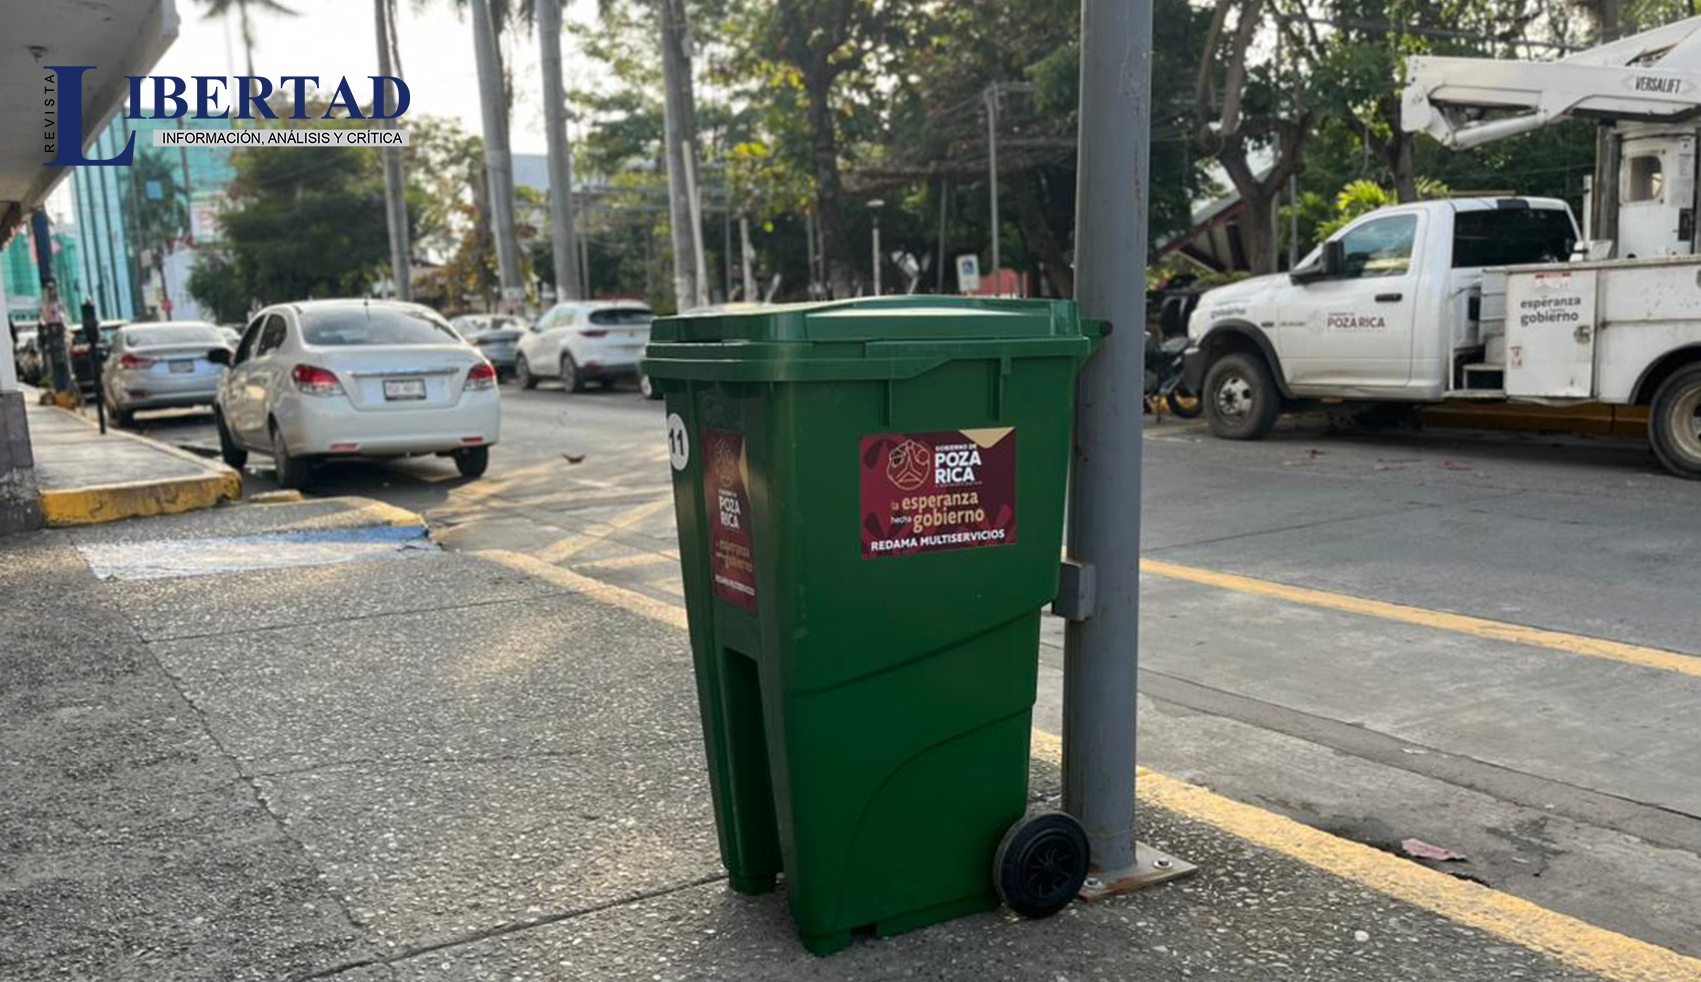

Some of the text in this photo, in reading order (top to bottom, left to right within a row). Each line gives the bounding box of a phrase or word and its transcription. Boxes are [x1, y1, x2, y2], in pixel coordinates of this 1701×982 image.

[1635, 76, 1682, 94] VERSALIFT
[1520, 296, 1582, 311] esperanza
[1327, 316, 1386, 330] POZA RICA
[1520, 311, 1580, 327] gobierno
[669, 428, 685, 457] 11
[934, 451, 982, 467] POZA
[934, 467, 975, 484] RICA
[718, 496, 741, 515] POZA
[902, 492, 979, 512] esperanza
[720, 511, 741, 530] RICA
[913, 507, 985, 534] gobierno
[870, 528, 1006, 552] REDAMA MULTISERVICIOS
